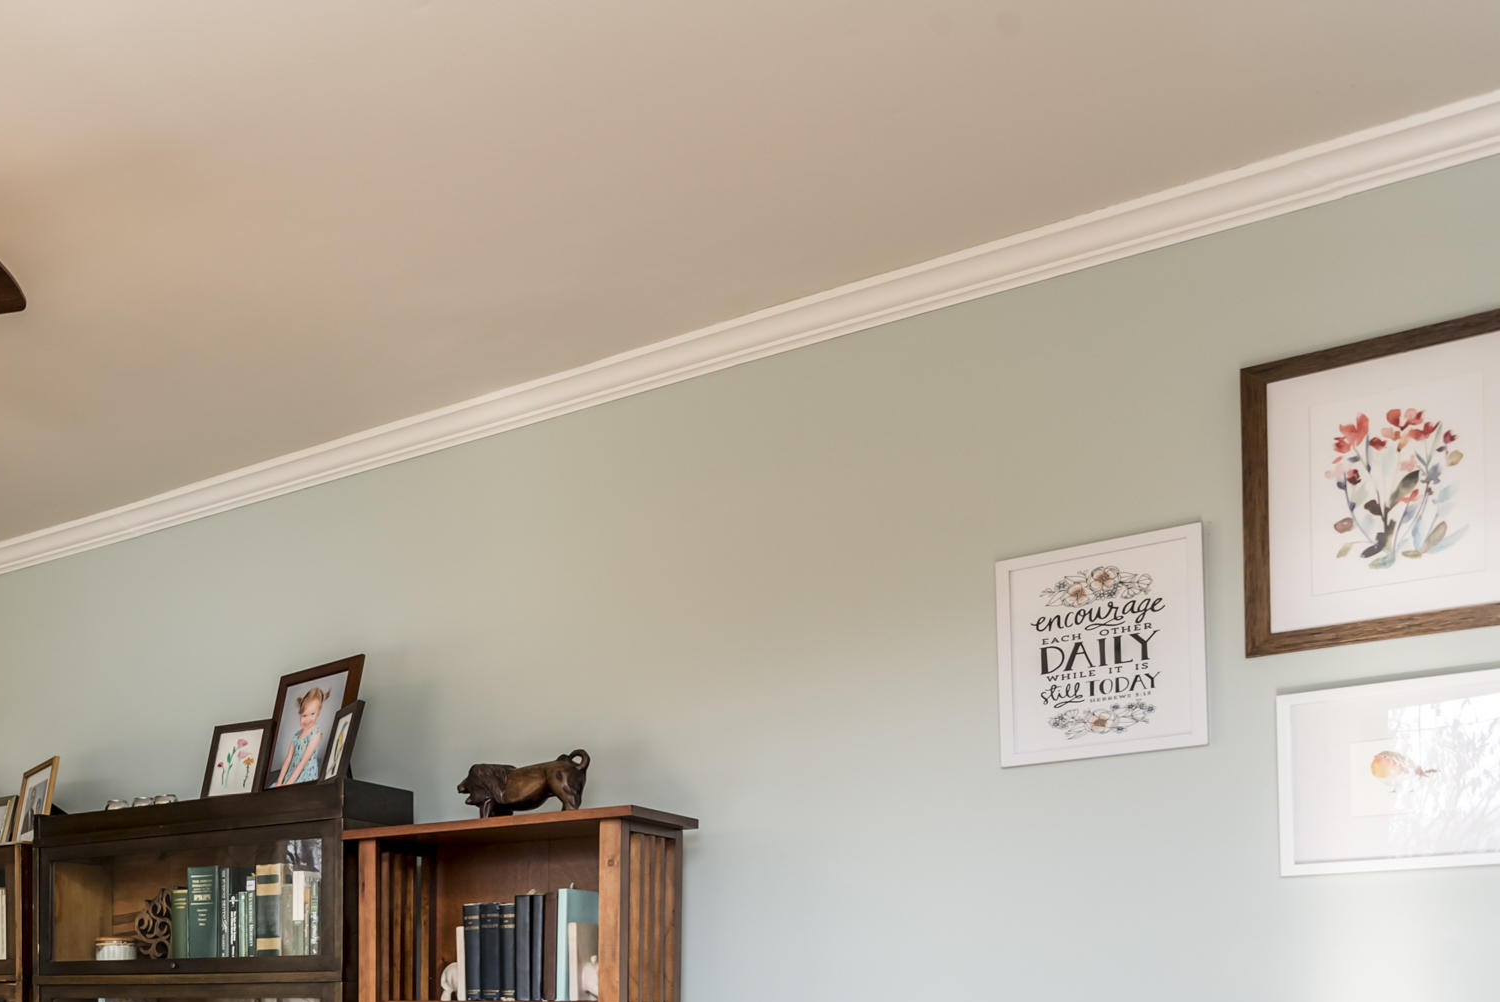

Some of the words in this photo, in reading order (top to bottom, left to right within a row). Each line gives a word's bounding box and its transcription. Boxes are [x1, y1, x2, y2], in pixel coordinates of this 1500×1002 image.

[1031, 597, 1166, 631] encourage
[1042, 633, 1082, 645] EACH
[1100, 623, 1152, 636] OTHER
[1040, 630, 1161, 675] DAILY
[1041, 682, 1085, 708] still
[1086, 671, 1161, 697] TODAY
[1047, 670, 1097, 682] WHILE
[1109, 666, 1123, 674] IT
[1135, 663, 1149, 671] IS
